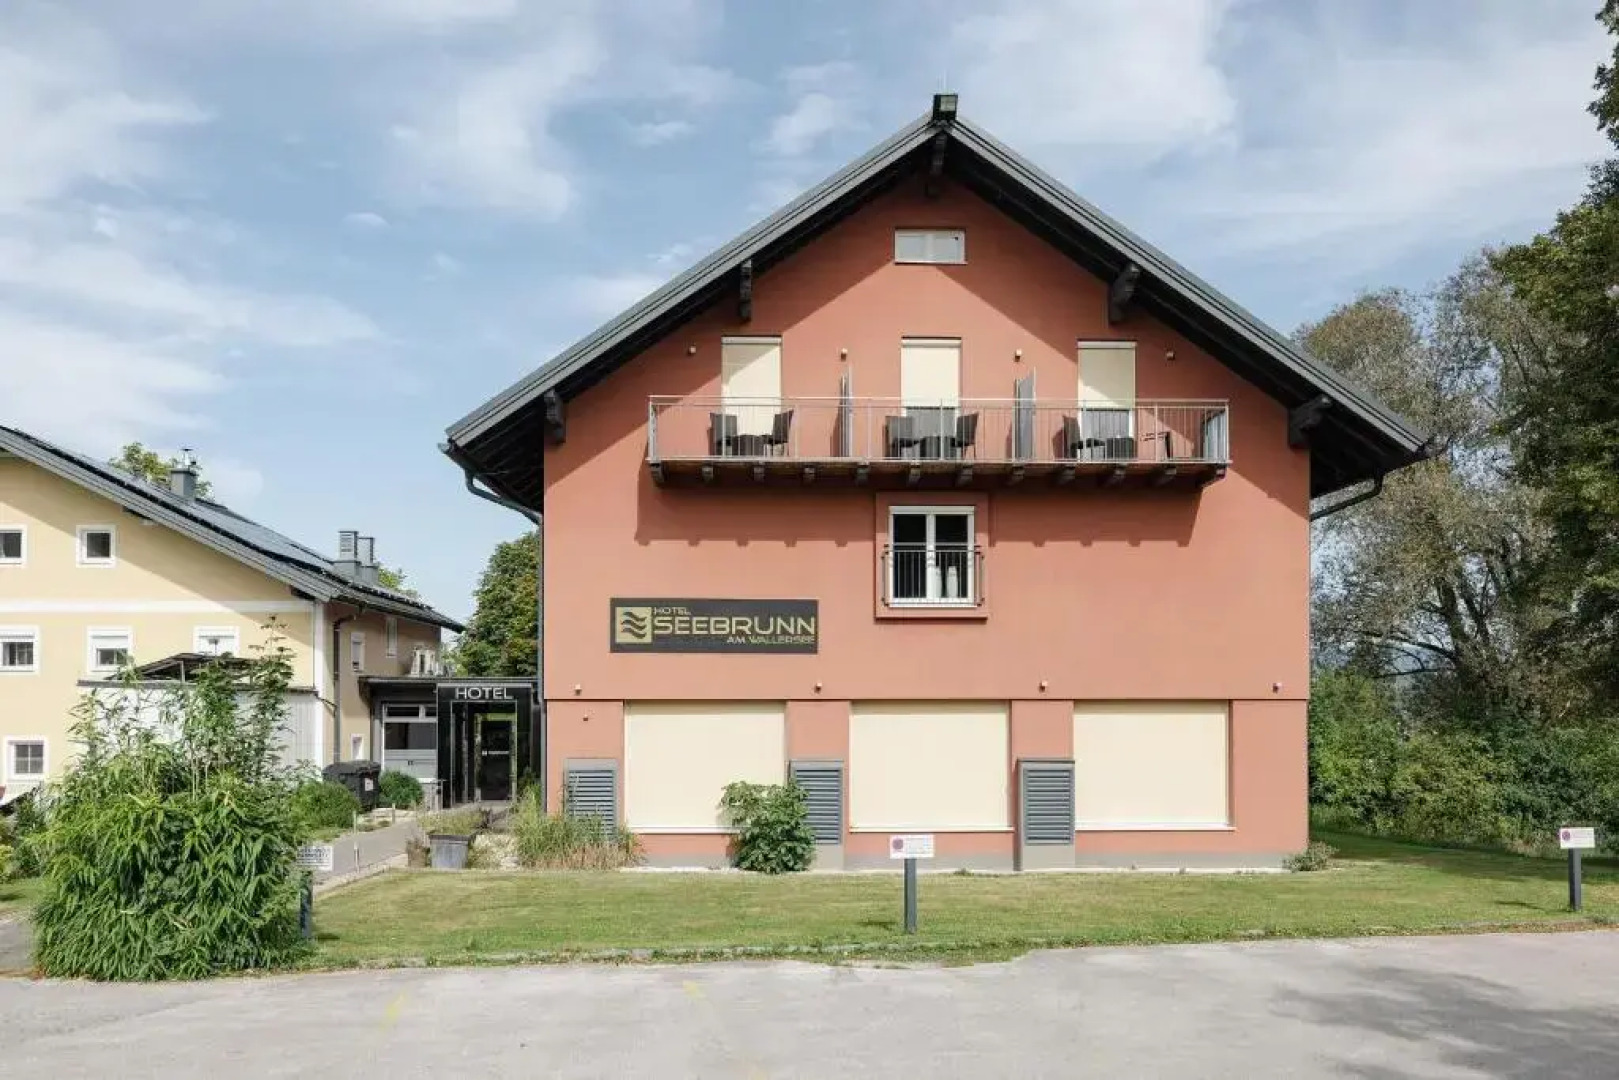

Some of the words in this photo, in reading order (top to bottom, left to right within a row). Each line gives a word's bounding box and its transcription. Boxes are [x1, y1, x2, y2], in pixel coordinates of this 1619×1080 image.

[653, 607, 691, 616] HOTEL
[653, 616, 815, 635] SEEBRUNN
[727, 636, 746, 644] AM
[749, 636, 815, 645] WALLERSEE
[455, 687, 513, 700] HOTEL
